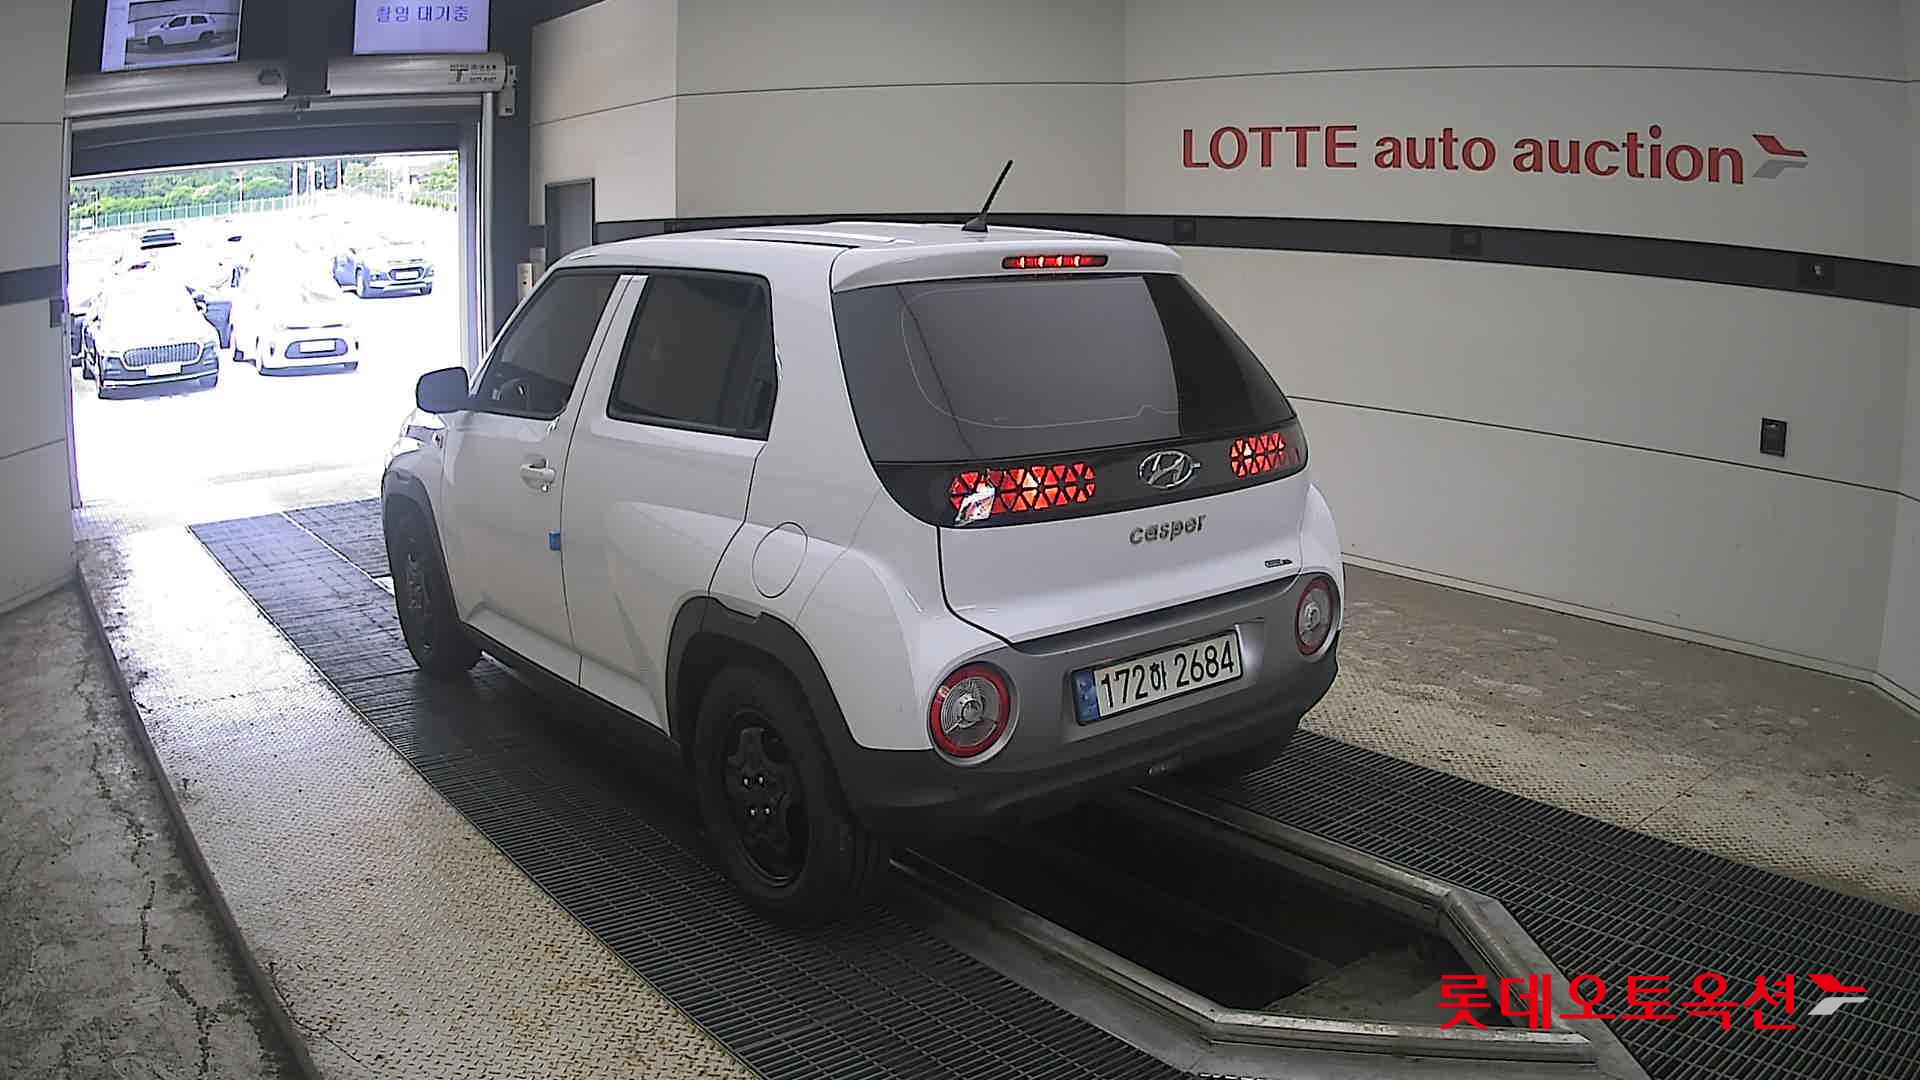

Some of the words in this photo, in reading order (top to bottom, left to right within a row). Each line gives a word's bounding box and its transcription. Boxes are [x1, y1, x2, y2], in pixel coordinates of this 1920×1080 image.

[417, 5, 469, 23] 대기중
[1182, 124, 1359, 170] LOTTE
[1374, 127, 1497, 172] auto
[1512, 124, 1745, 186] auction
[1128, 514, 1207, 545] casper
[1101, 659, 1168, 708] 172하
[1174, 640, 1235, 688] 2684
